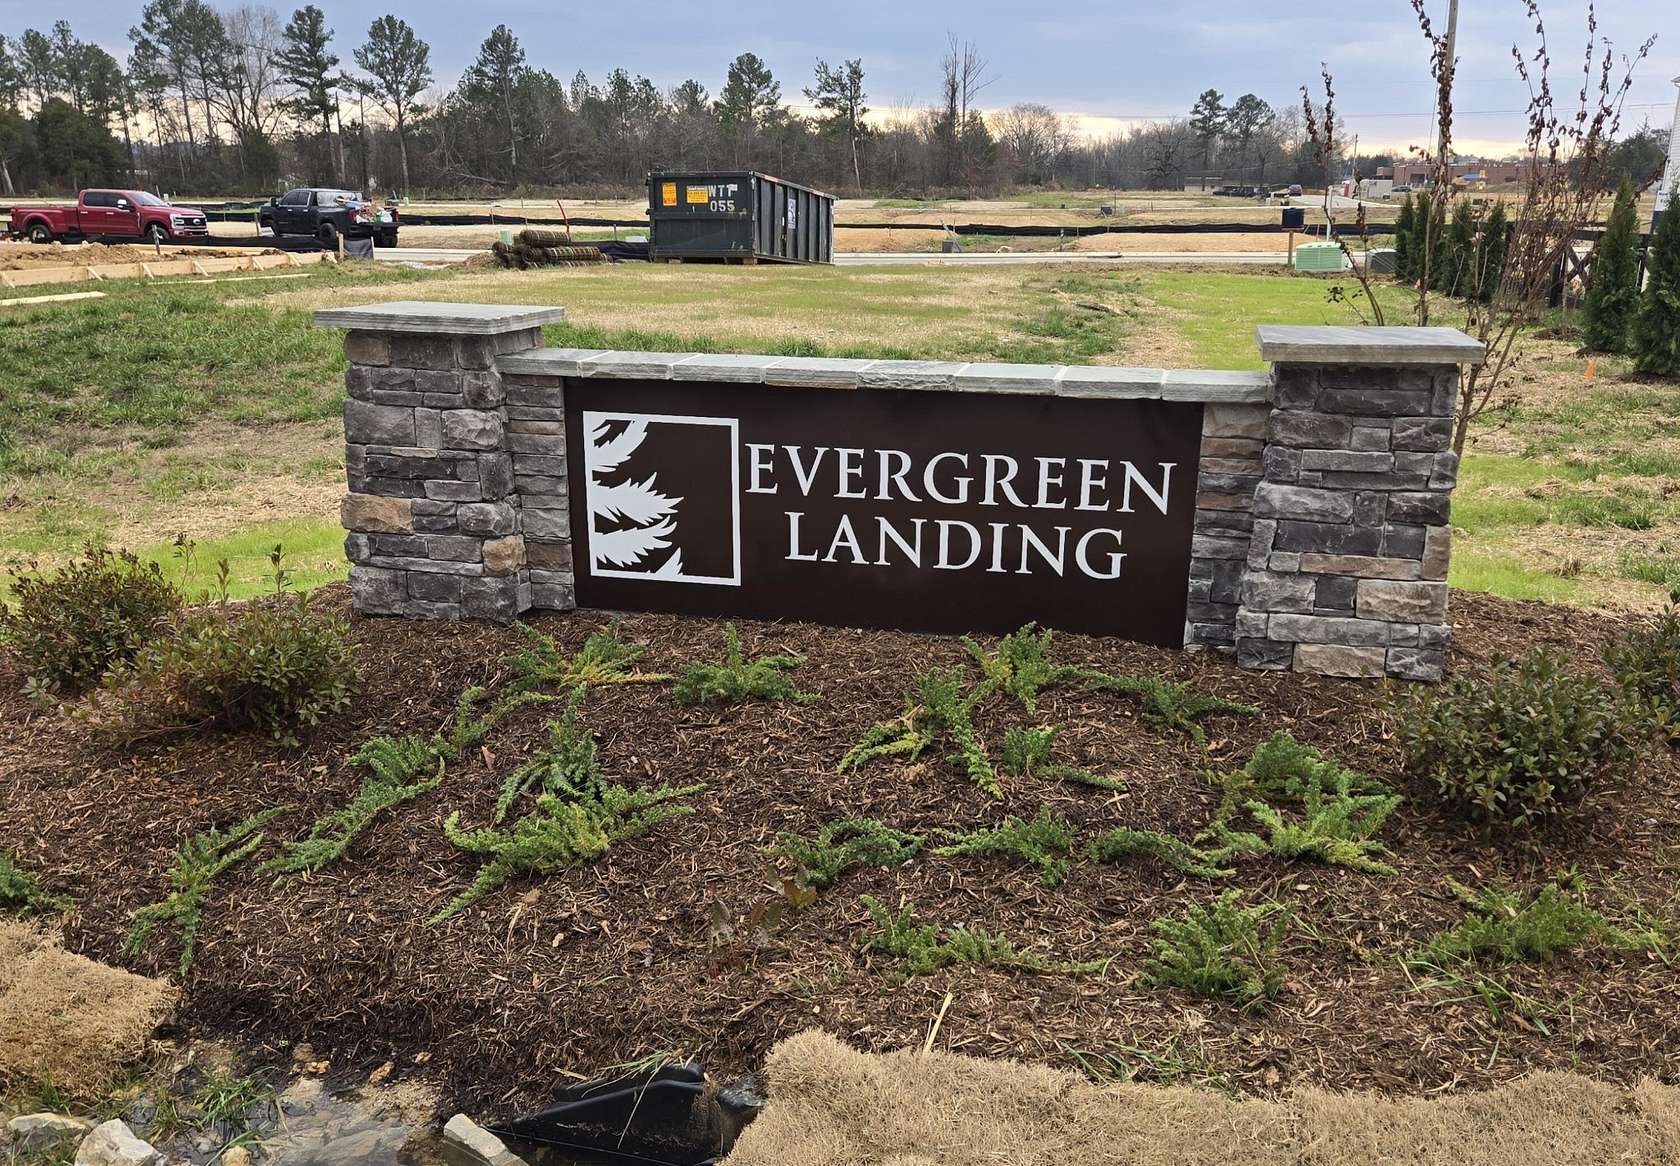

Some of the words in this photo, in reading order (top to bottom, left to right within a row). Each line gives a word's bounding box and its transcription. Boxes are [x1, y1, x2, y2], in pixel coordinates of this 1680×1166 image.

[710, 199, 735, 212] 055
[744, 443, 1178, 516] EVERGREEN
[784, 511, 1128, 580] LANDING
